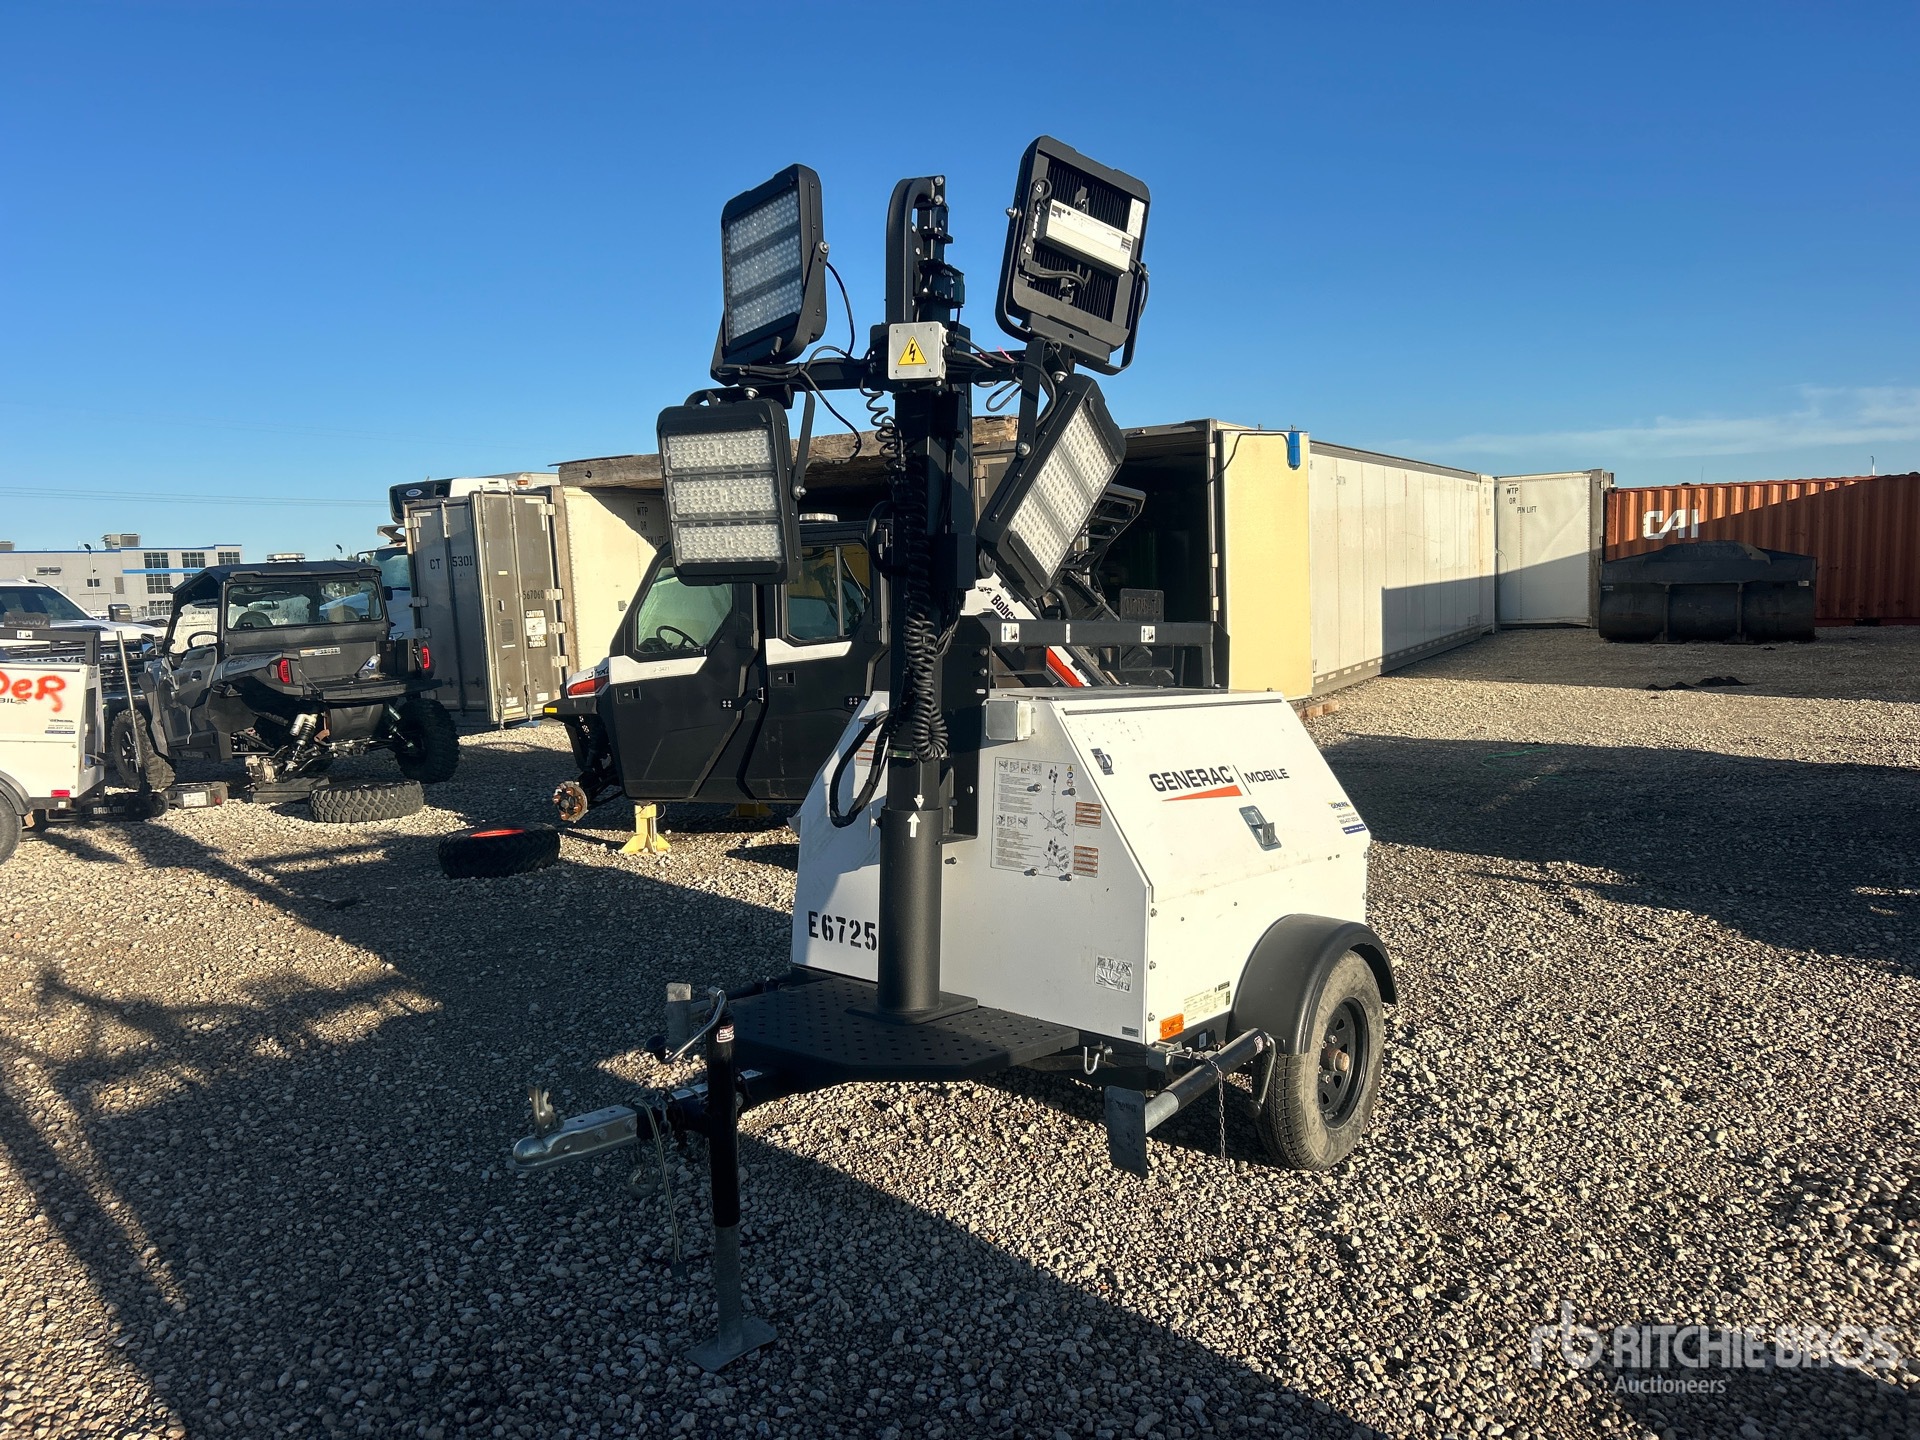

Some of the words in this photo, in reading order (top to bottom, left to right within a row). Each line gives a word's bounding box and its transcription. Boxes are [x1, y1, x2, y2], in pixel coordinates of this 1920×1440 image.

[1643, 509, 1699, 540] CAI
[430, 558, 441, 570] CT
[452, 555, 473, 567] 5301
[991, 594, 1016, 619] Bobc
[1149, 765, 1235, 792] GENERAC
[1244, 768, 1290, 784] MOBILE
[808, 910, 878, 951] E6725
